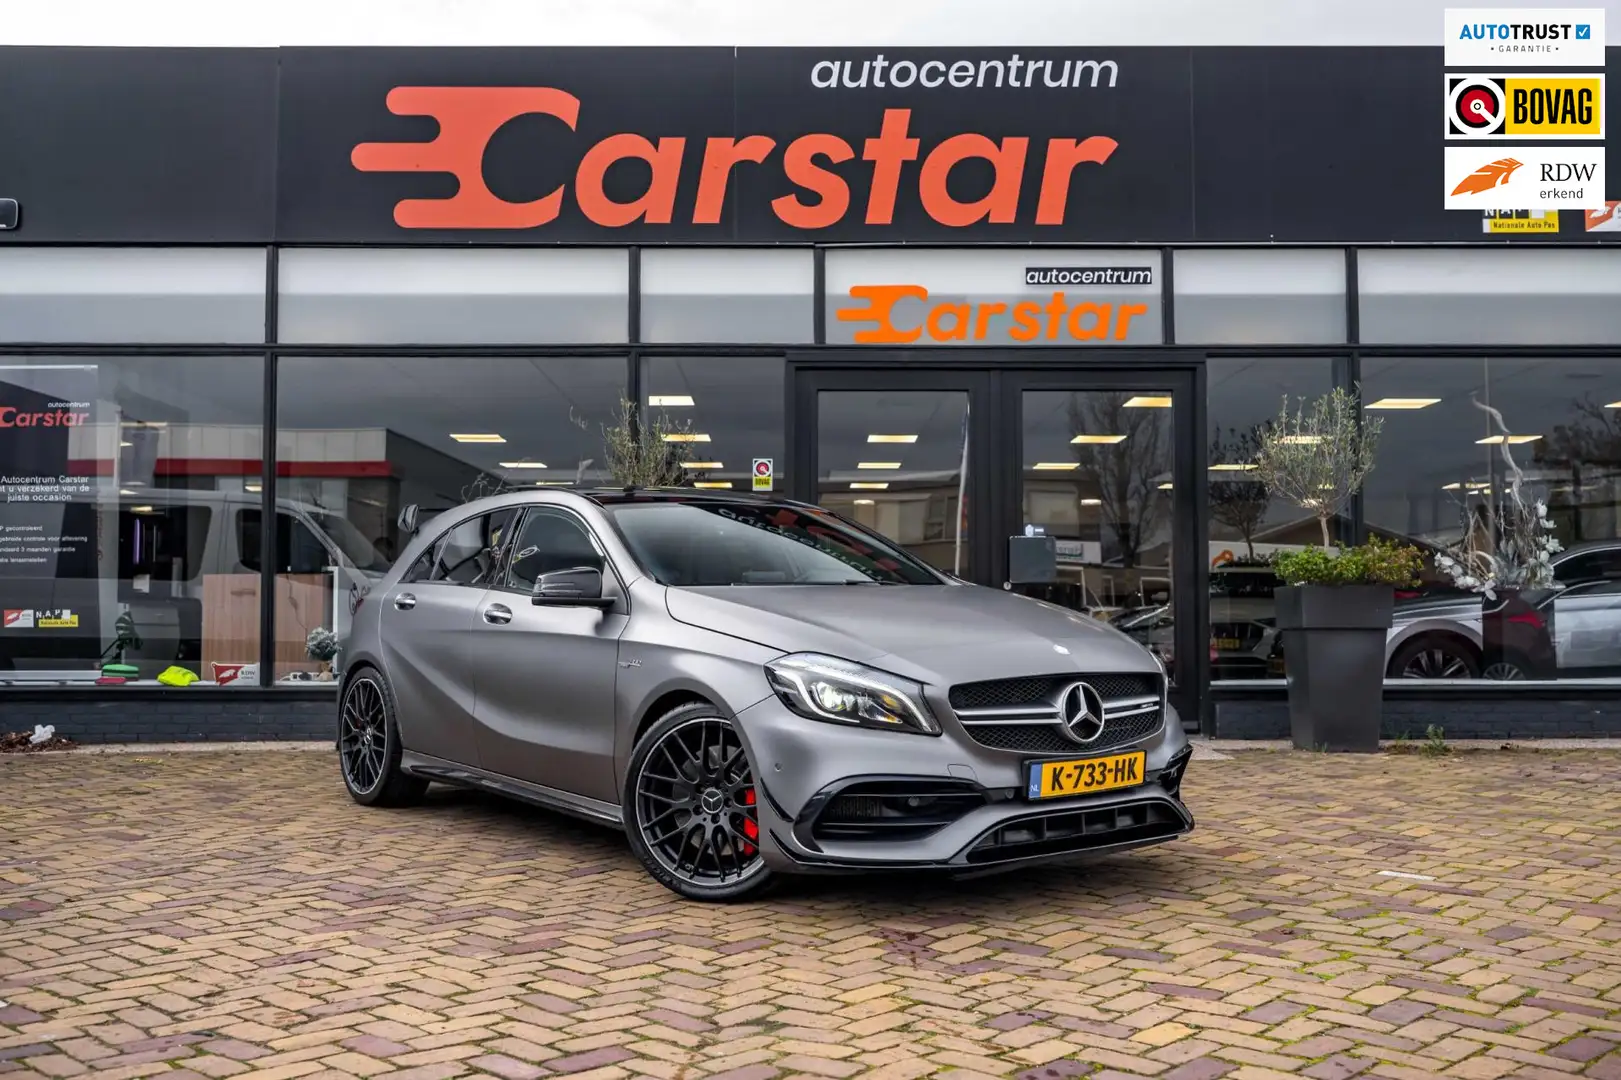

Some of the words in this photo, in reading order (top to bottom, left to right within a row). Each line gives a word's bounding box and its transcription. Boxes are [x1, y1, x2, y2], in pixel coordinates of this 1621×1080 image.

[810, 54, 1119, 89] autocentrum
[351, 86, 1119, 230] Carstar
[1493, 221, 1525, 229] Nationale
[1527, 221, 1542, 229] Auto
[1026, 268, 1152, 284] autocentrum
[836, 284, 1148, 343] Carstar
[0, 406, 89, 427] Carstar
[17, 484, 59, 492] verzekerd
[79, 484, 90, 492] de
[59, 475, 89, 483] Carstar
[7, 493, 30, 503] juiste
[32, 493, 72, 501] occasion
[1029, 784, 1040, 792] NL
[1051, 757, 1138, 791] K-733-HK
